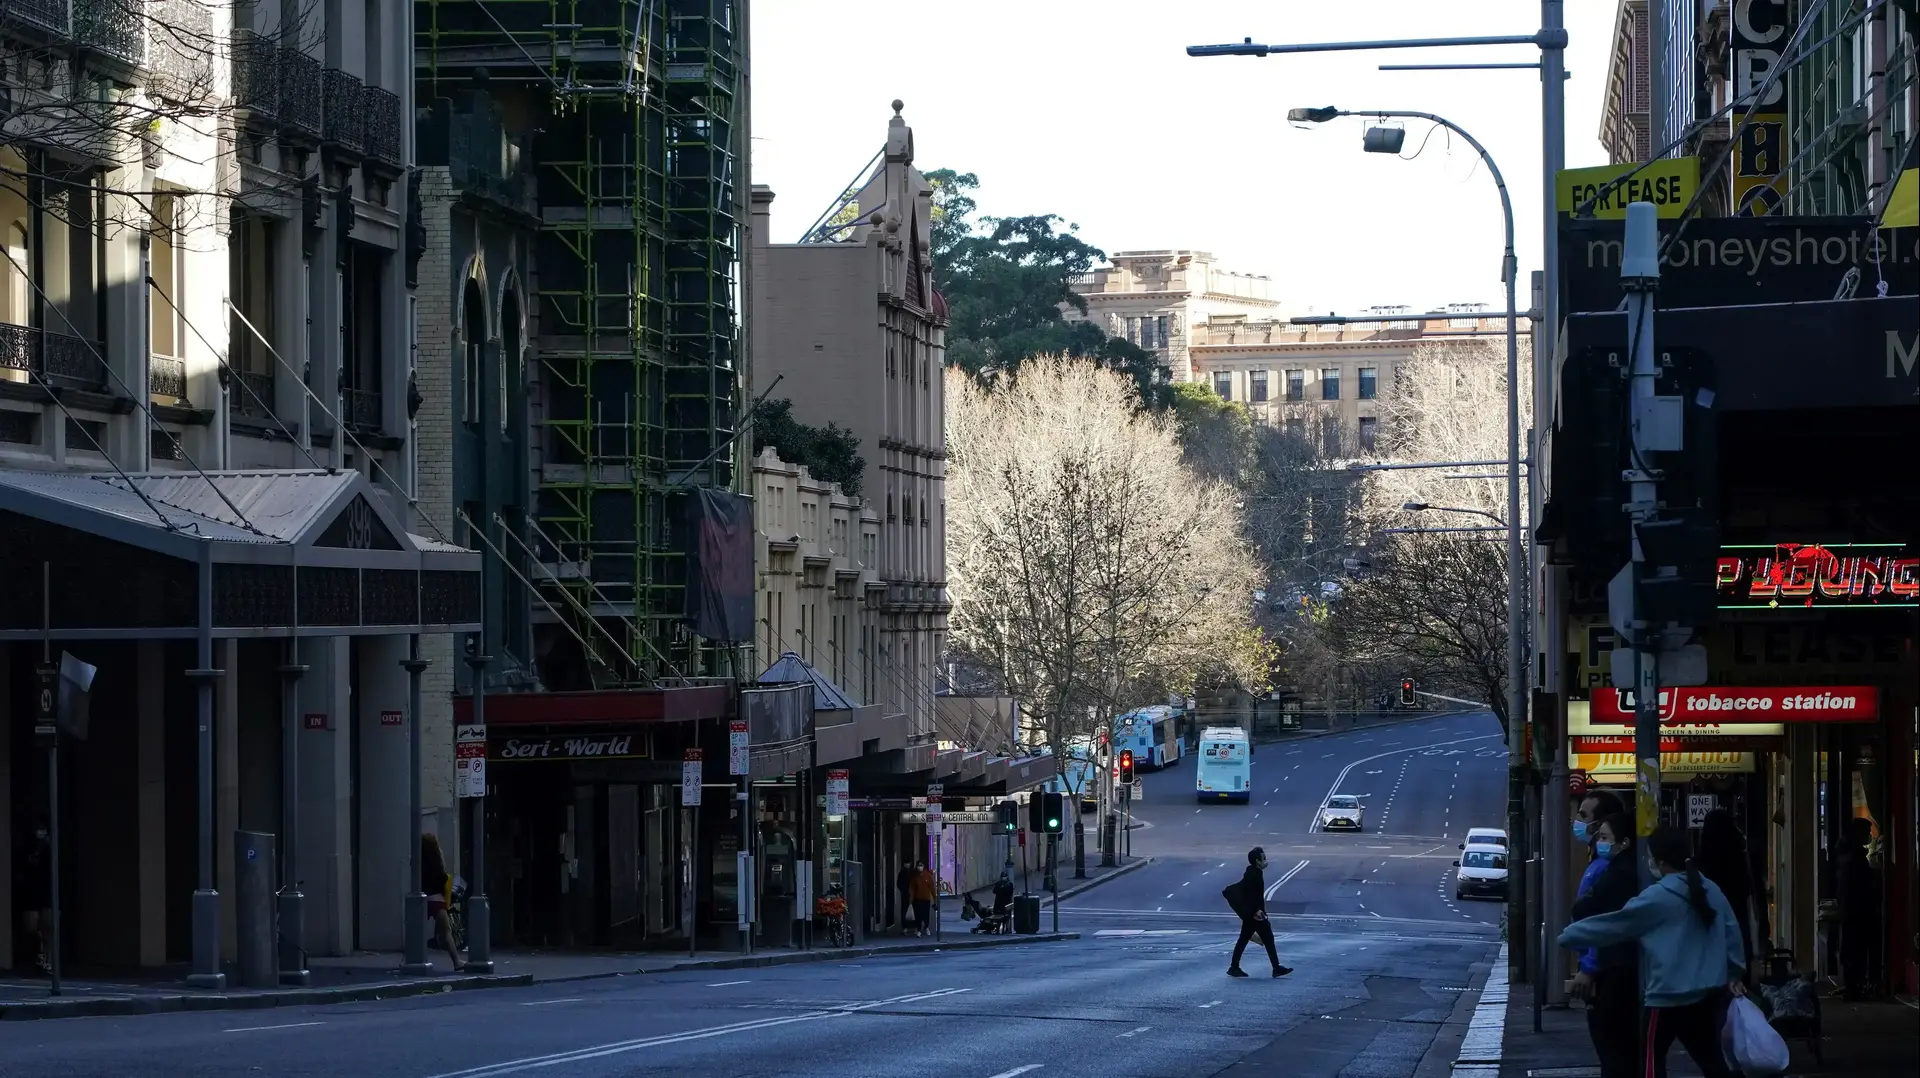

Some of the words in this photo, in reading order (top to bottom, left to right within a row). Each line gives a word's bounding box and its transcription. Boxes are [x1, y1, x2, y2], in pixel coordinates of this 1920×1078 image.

[1571, 183, 1610, 212] FOR
[1616, 174, 1681, 209] LEASE
[1687, 693, 1772, 711] tobacco
[1782, 691, 1856, 710] station
[310, 717, 321, 726] IN
[382, 714, 402, 722] OUT
[564, 735, 632, 756] World
[1691, 797, 1710, 806] ONE
[1690, 807, 1711, 816] WAY
[948, 812, 976, 822] CENTRAL
